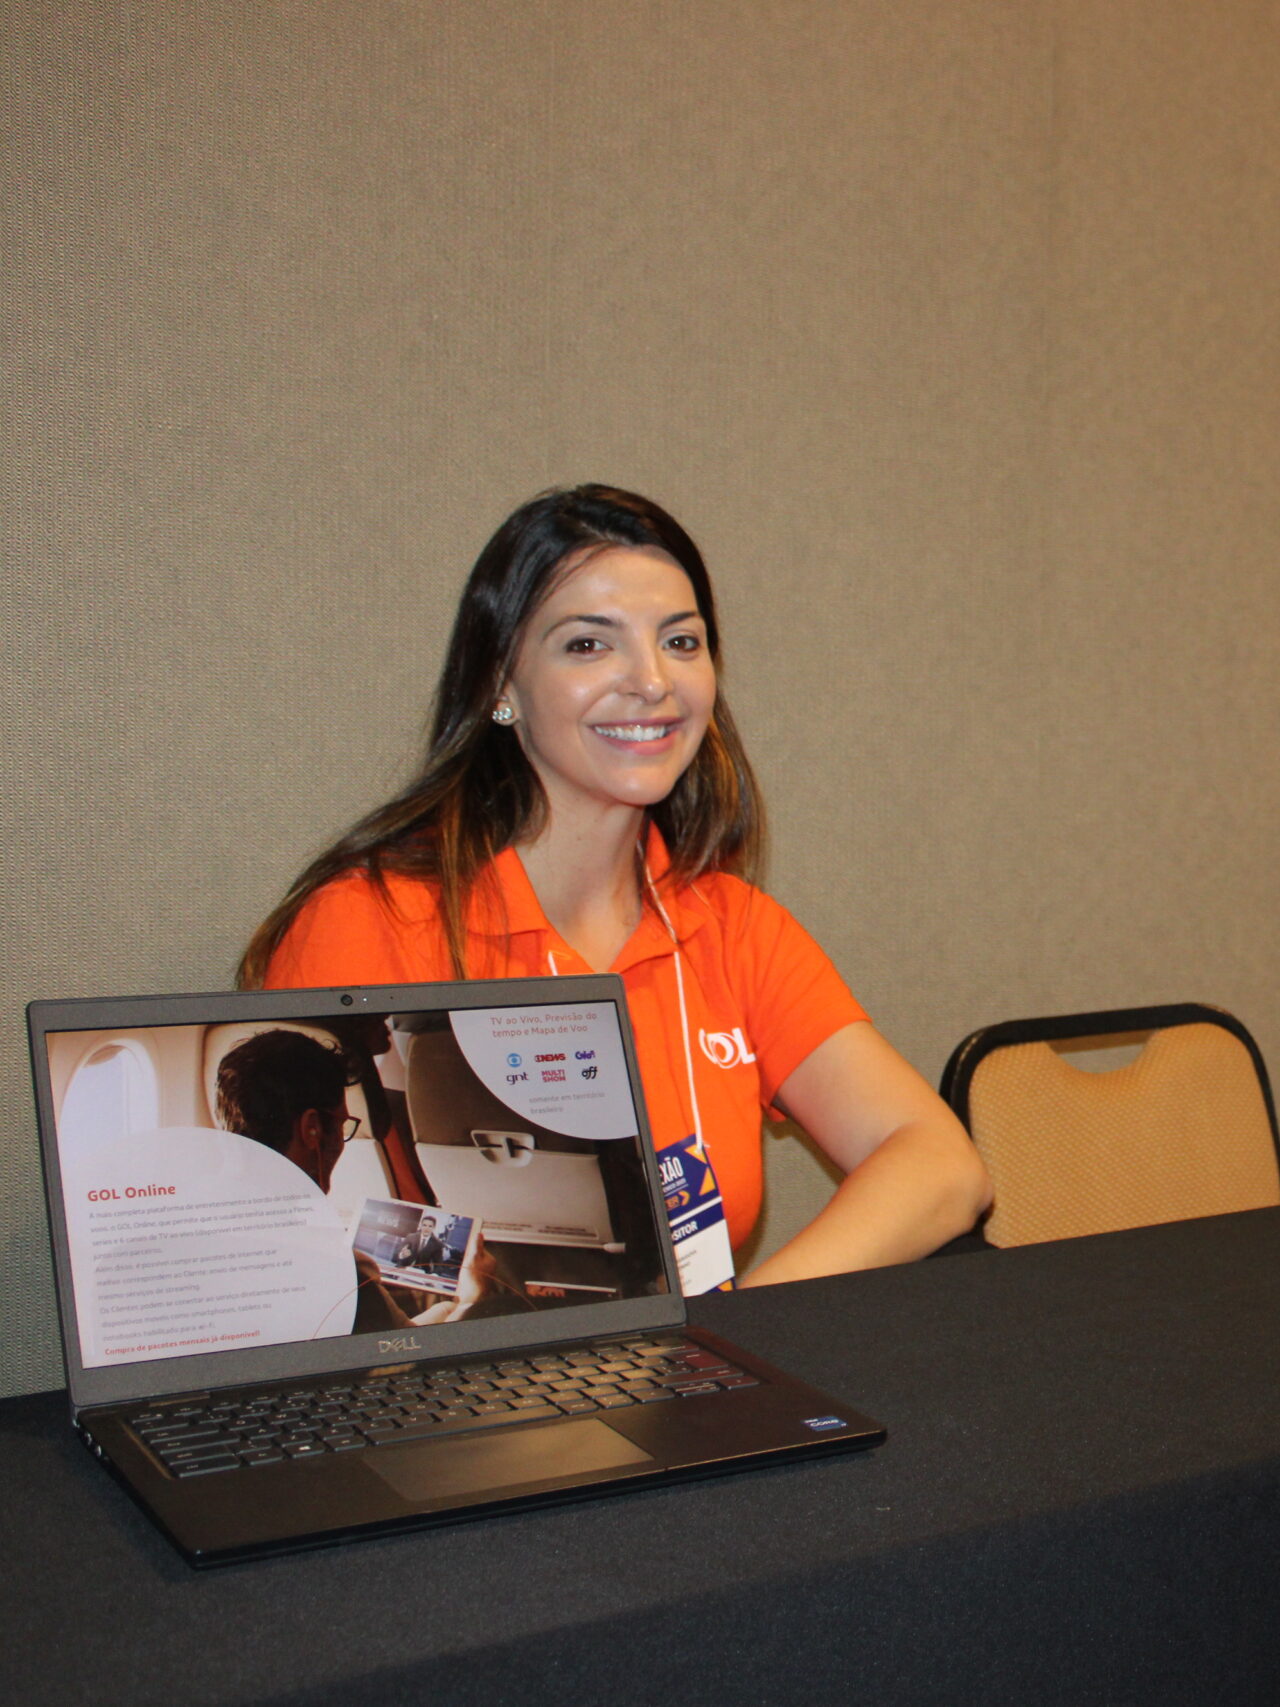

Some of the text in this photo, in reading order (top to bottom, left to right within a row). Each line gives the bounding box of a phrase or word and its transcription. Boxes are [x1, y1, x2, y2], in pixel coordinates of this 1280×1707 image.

[490, 1016, 502, 1025] TV
[492, 1029, 521, 1038] tempo
[531, 1026, 556, 1036] Mapa
[559, 1025, 568, 1034] de
[571, 1023, 588, 1032] Voo
[506, 1072, 528, 1085] gnt
[541, 1069, 565, 1077] MULTI
[581, 1066, 597, 1080] off
[659, 1156, 684, 1186] XÃO
[87, 1184, 176, 1202] GOL Online
[104, 1344, 136, 1356] Compra
[148, 1339, 178, 1351] pacotes
[378, 1336, 421, 1353] DELL
